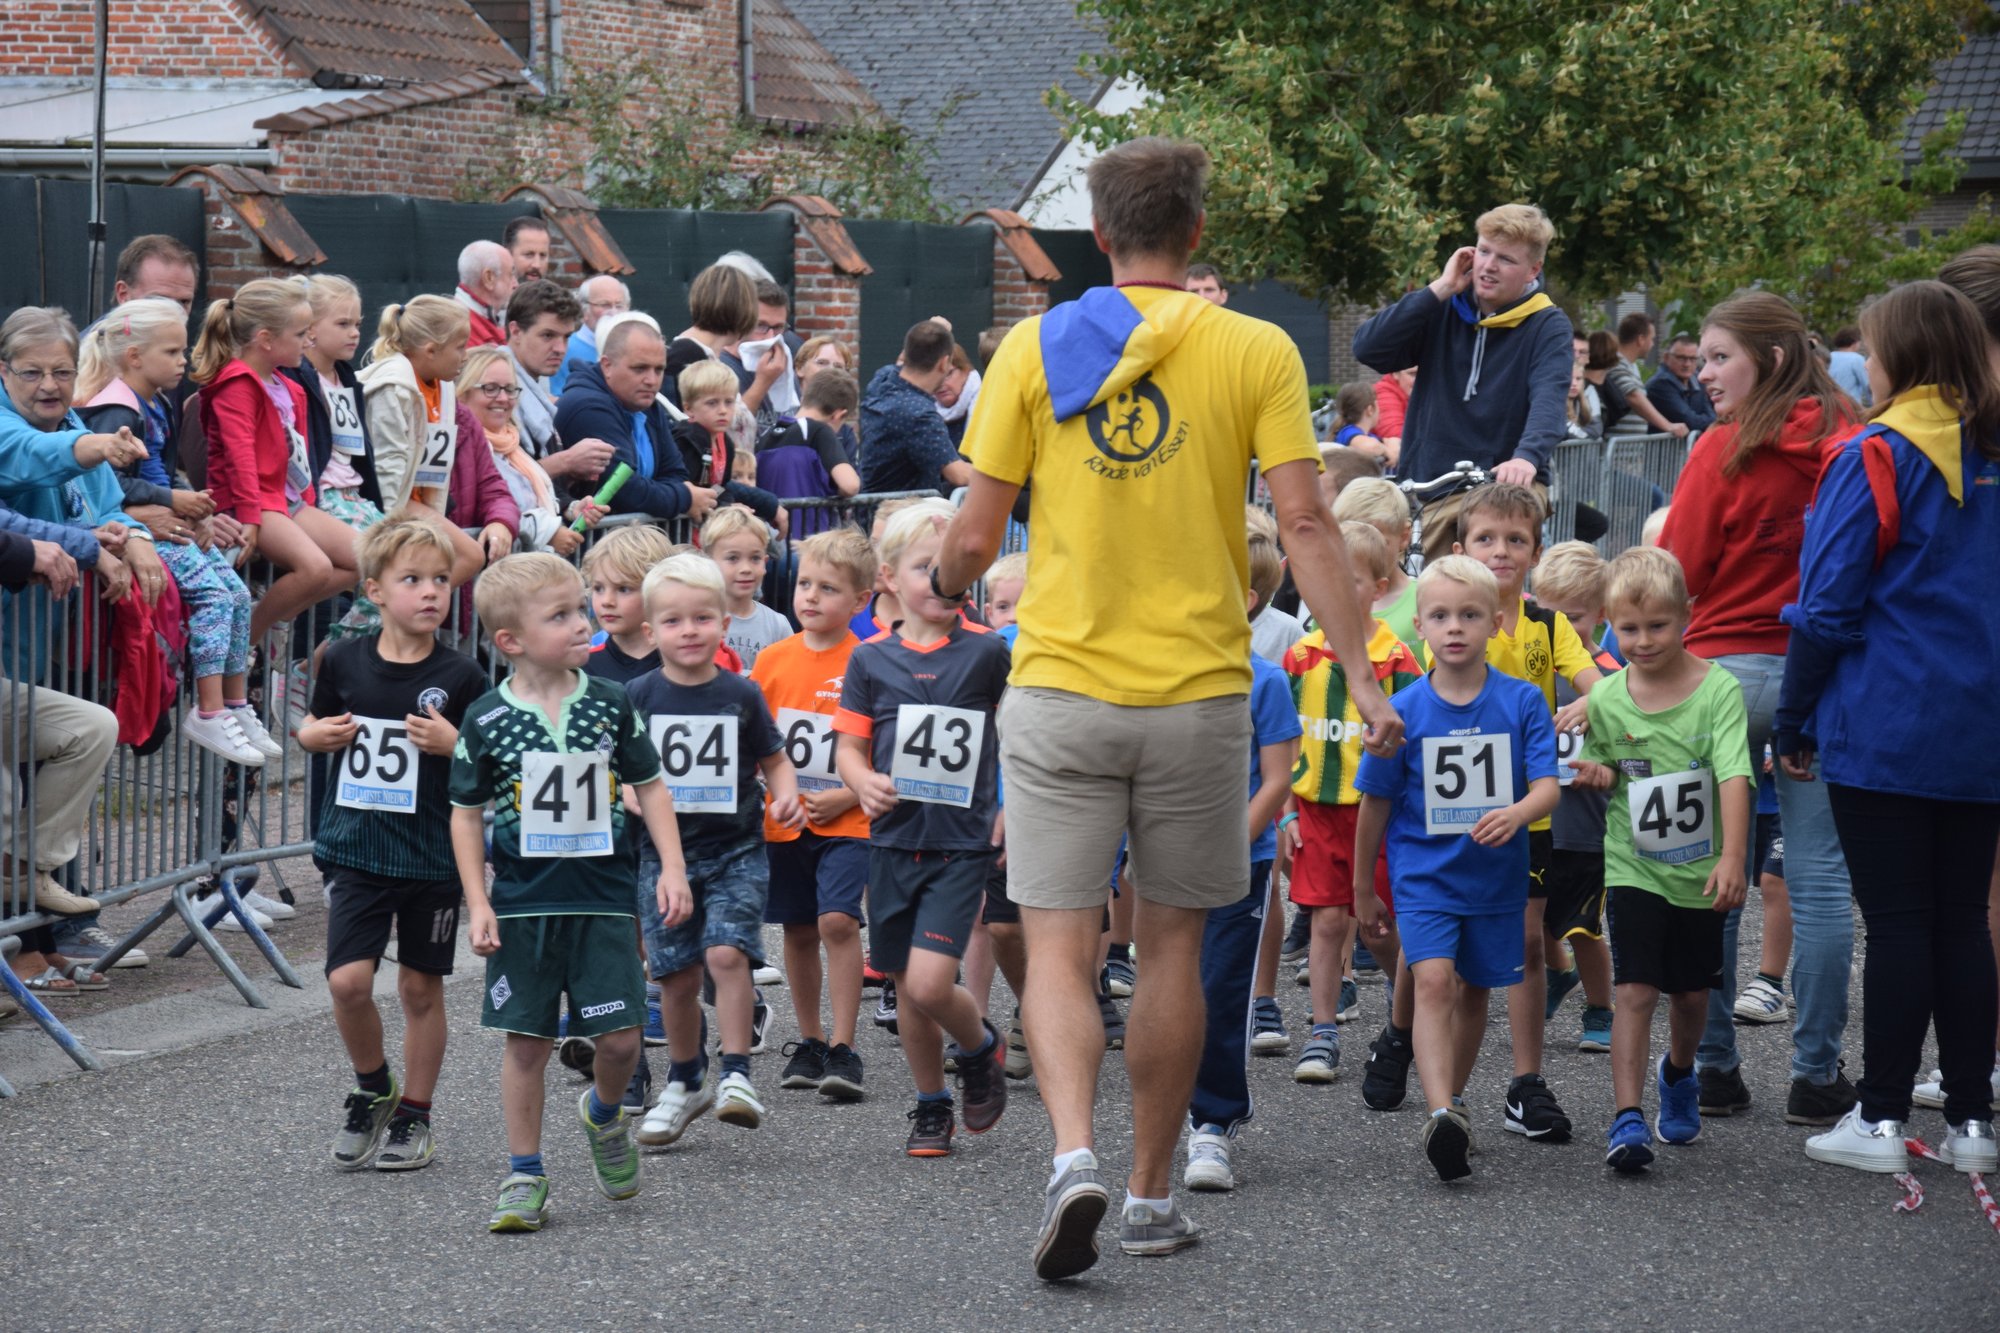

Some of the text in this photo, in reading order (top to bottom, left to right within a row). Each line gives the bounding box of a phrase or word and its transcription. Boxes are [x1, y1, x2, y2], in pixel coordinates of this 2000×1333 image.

[328, 390, 359, 429] 83
[1083, 420, 1190, 481] Ronde van Essen
[348, 723, 408, 783] 65
[661, 723, 731, 777] 64
[785, 719, 839, 774] 61
[902, 713, 972, 773] 43
[532, 763, 597, 823] 41
[1434, 742, 1496, 800] 51
[1435, 809, 1450, 823] HET
[1450, 808, 1479, 823] LAATSTE
[1638, 780, 1705, 839] 45
[530, 834, 607, 851] HET LAATSTE NIEUWS
[429, 908, 454, 944] 10
[582, 1001, 625, 1018] Kappa
